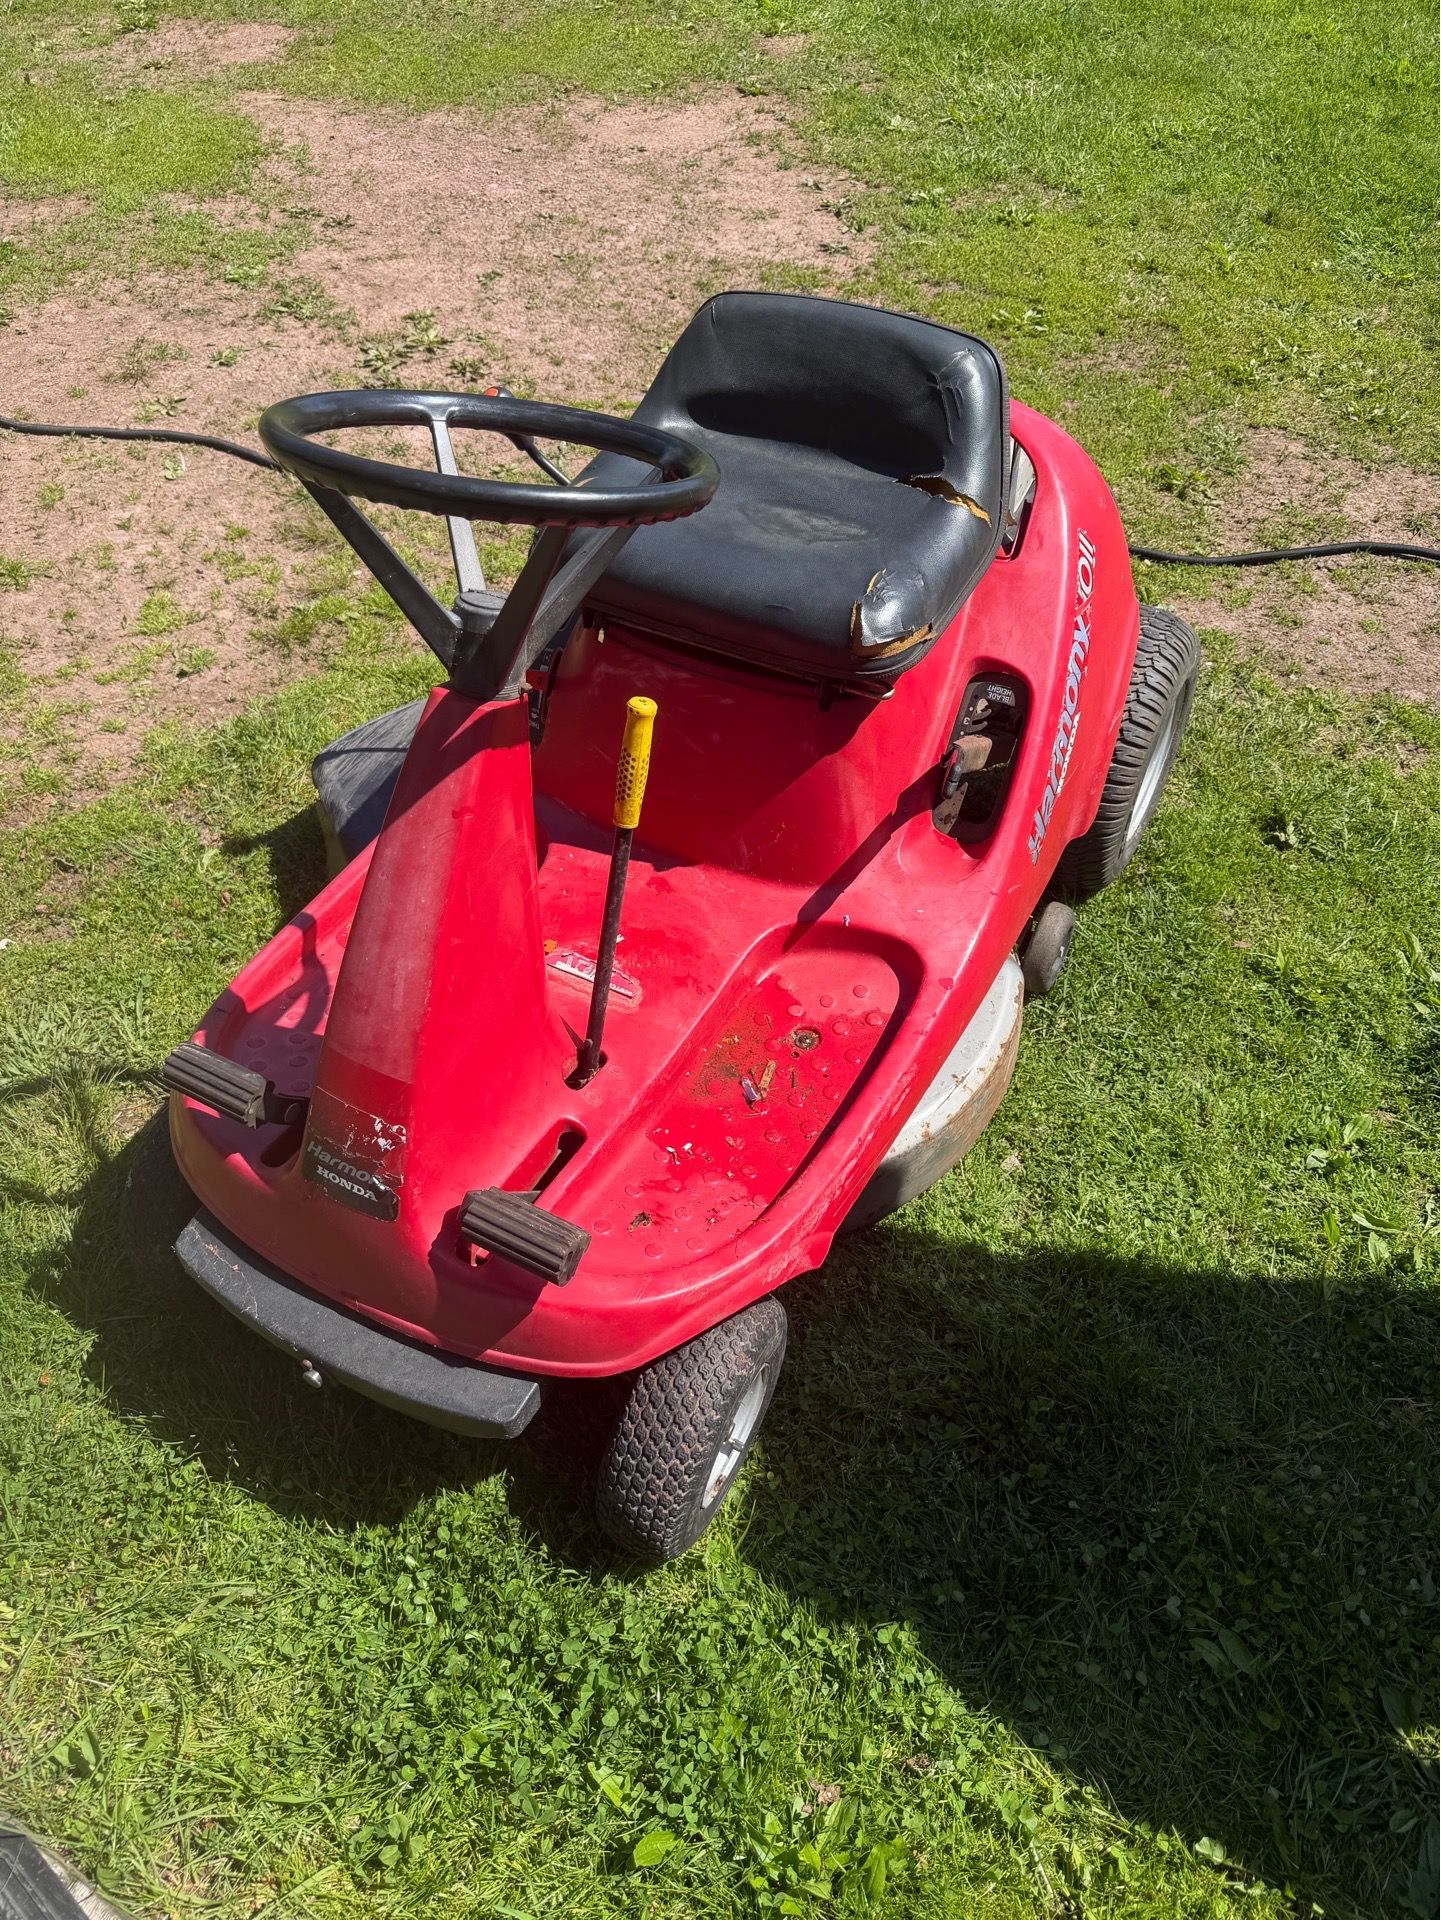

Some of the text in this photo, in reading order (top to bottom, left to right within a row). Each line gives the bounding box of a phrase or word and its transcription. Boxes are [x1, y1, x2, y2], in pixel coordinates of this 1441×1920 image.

[987, 684, 1012, 697] HEIGHT
[988, 691, 1010, 704] BLADE
[963, 716, 970, 725] 3
[1028, 613, 1091, 865] Harmony
[1056, 711, 1081, 796] HONDA
[316, 1165, 378, 1202] HONDA
